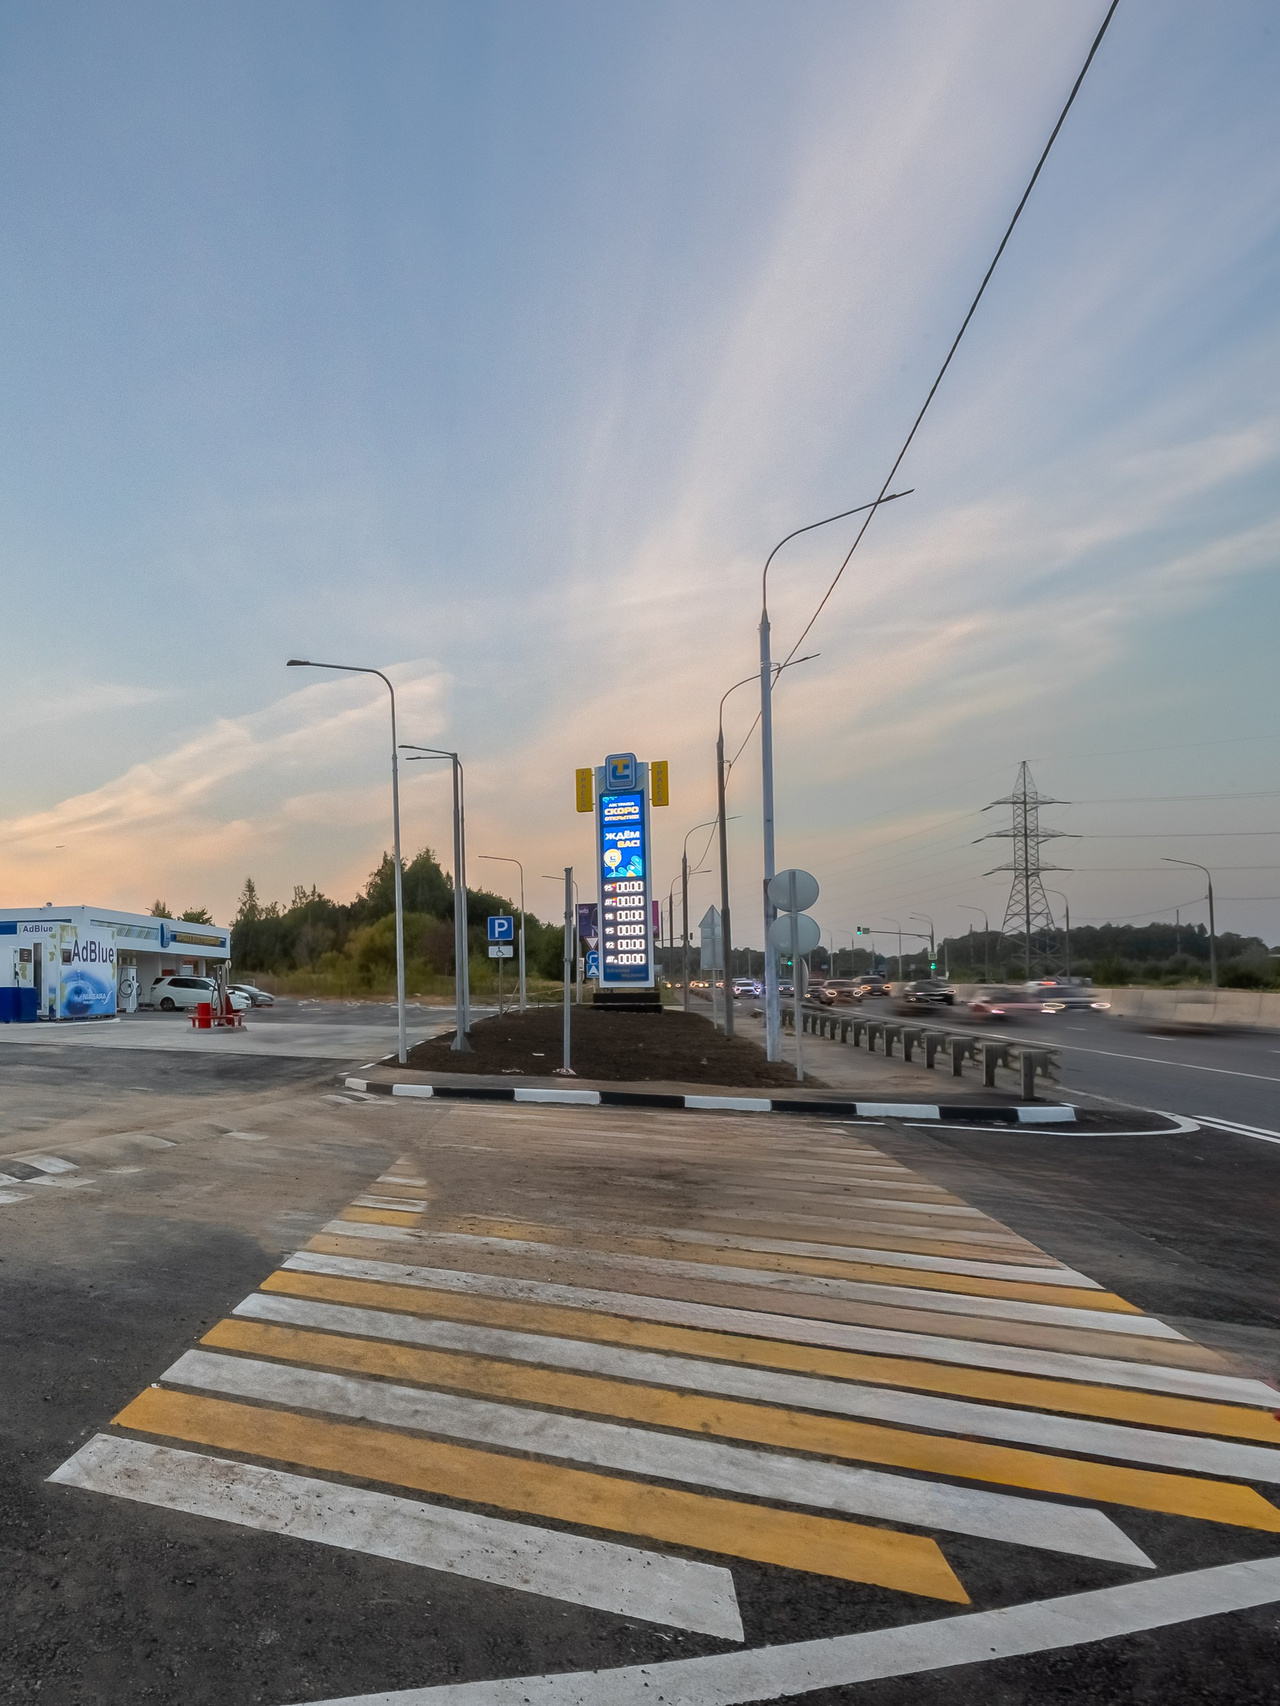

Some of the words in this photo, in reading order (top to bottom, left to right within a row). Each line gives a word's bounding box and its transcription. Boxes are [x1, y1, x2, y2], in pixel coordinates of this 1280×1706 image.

[604, 806, 639, 815] СКОРО
[605, 830, 640, 840] ЖДЁМ
[23, 925, 53, 933] AdBlue
[495, 919, 508, 938] P
[72, 939, 114, 963] AdBlue
